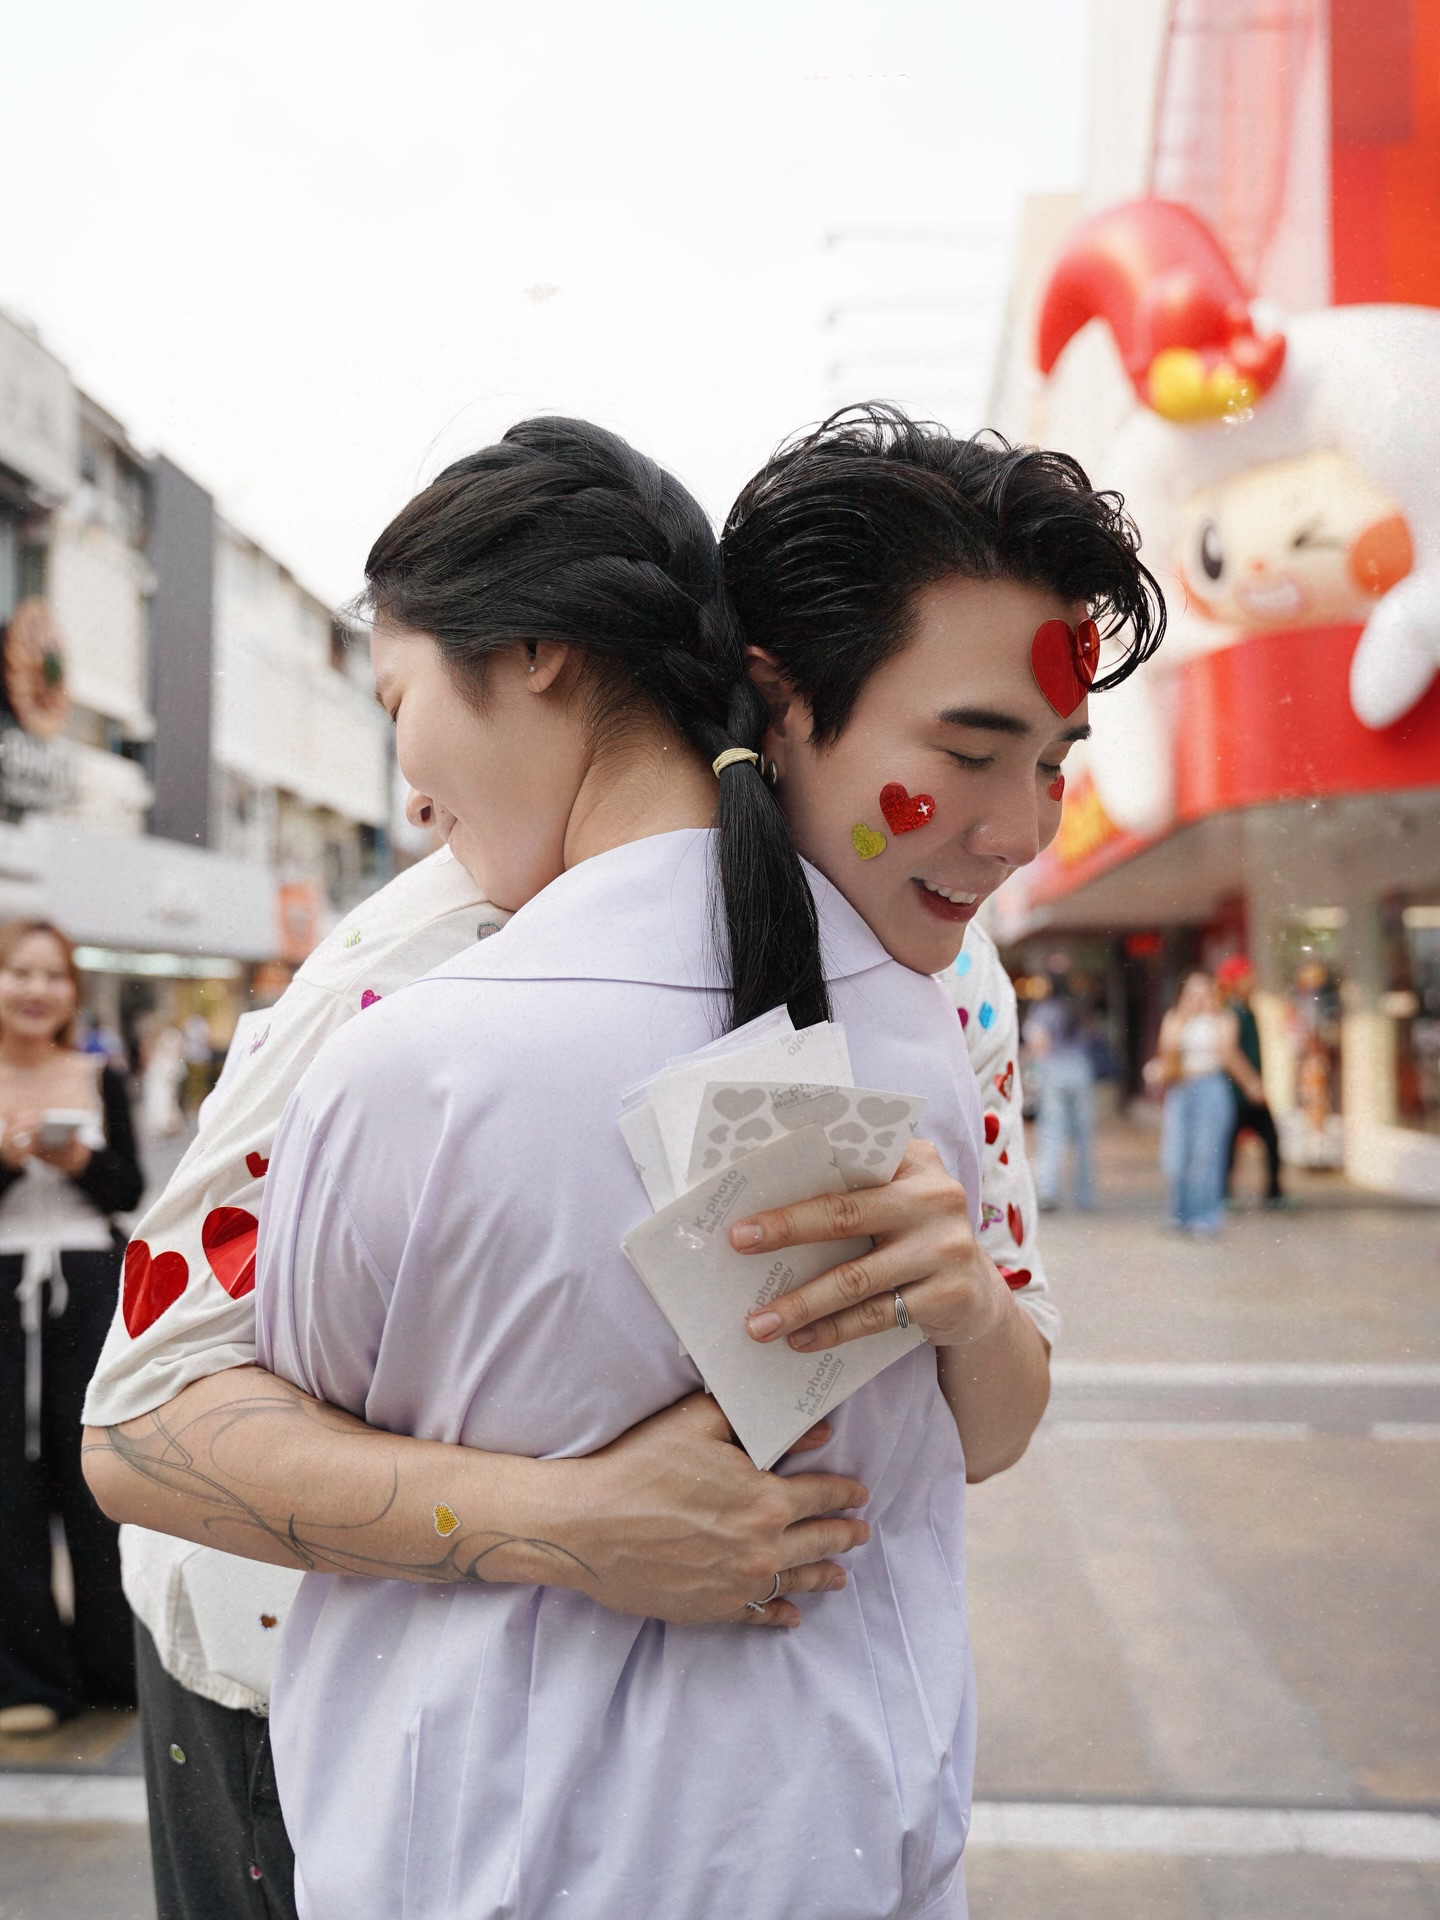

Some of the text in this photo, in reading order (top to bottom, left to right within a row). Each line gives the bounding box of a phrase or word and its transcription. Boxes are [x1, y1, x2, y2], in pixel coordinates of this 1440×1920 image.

[769, 1083, 819, 1102] K-ph
[693, 1170, 737, 1229] K-photo
[705, 1175, 748, 1234] Best Quality
[770, 1266, 794, 1301] Quality
[795, 1353, 833, 1413] K-photo
[807, 1358, 843, 1416] Best Quality
